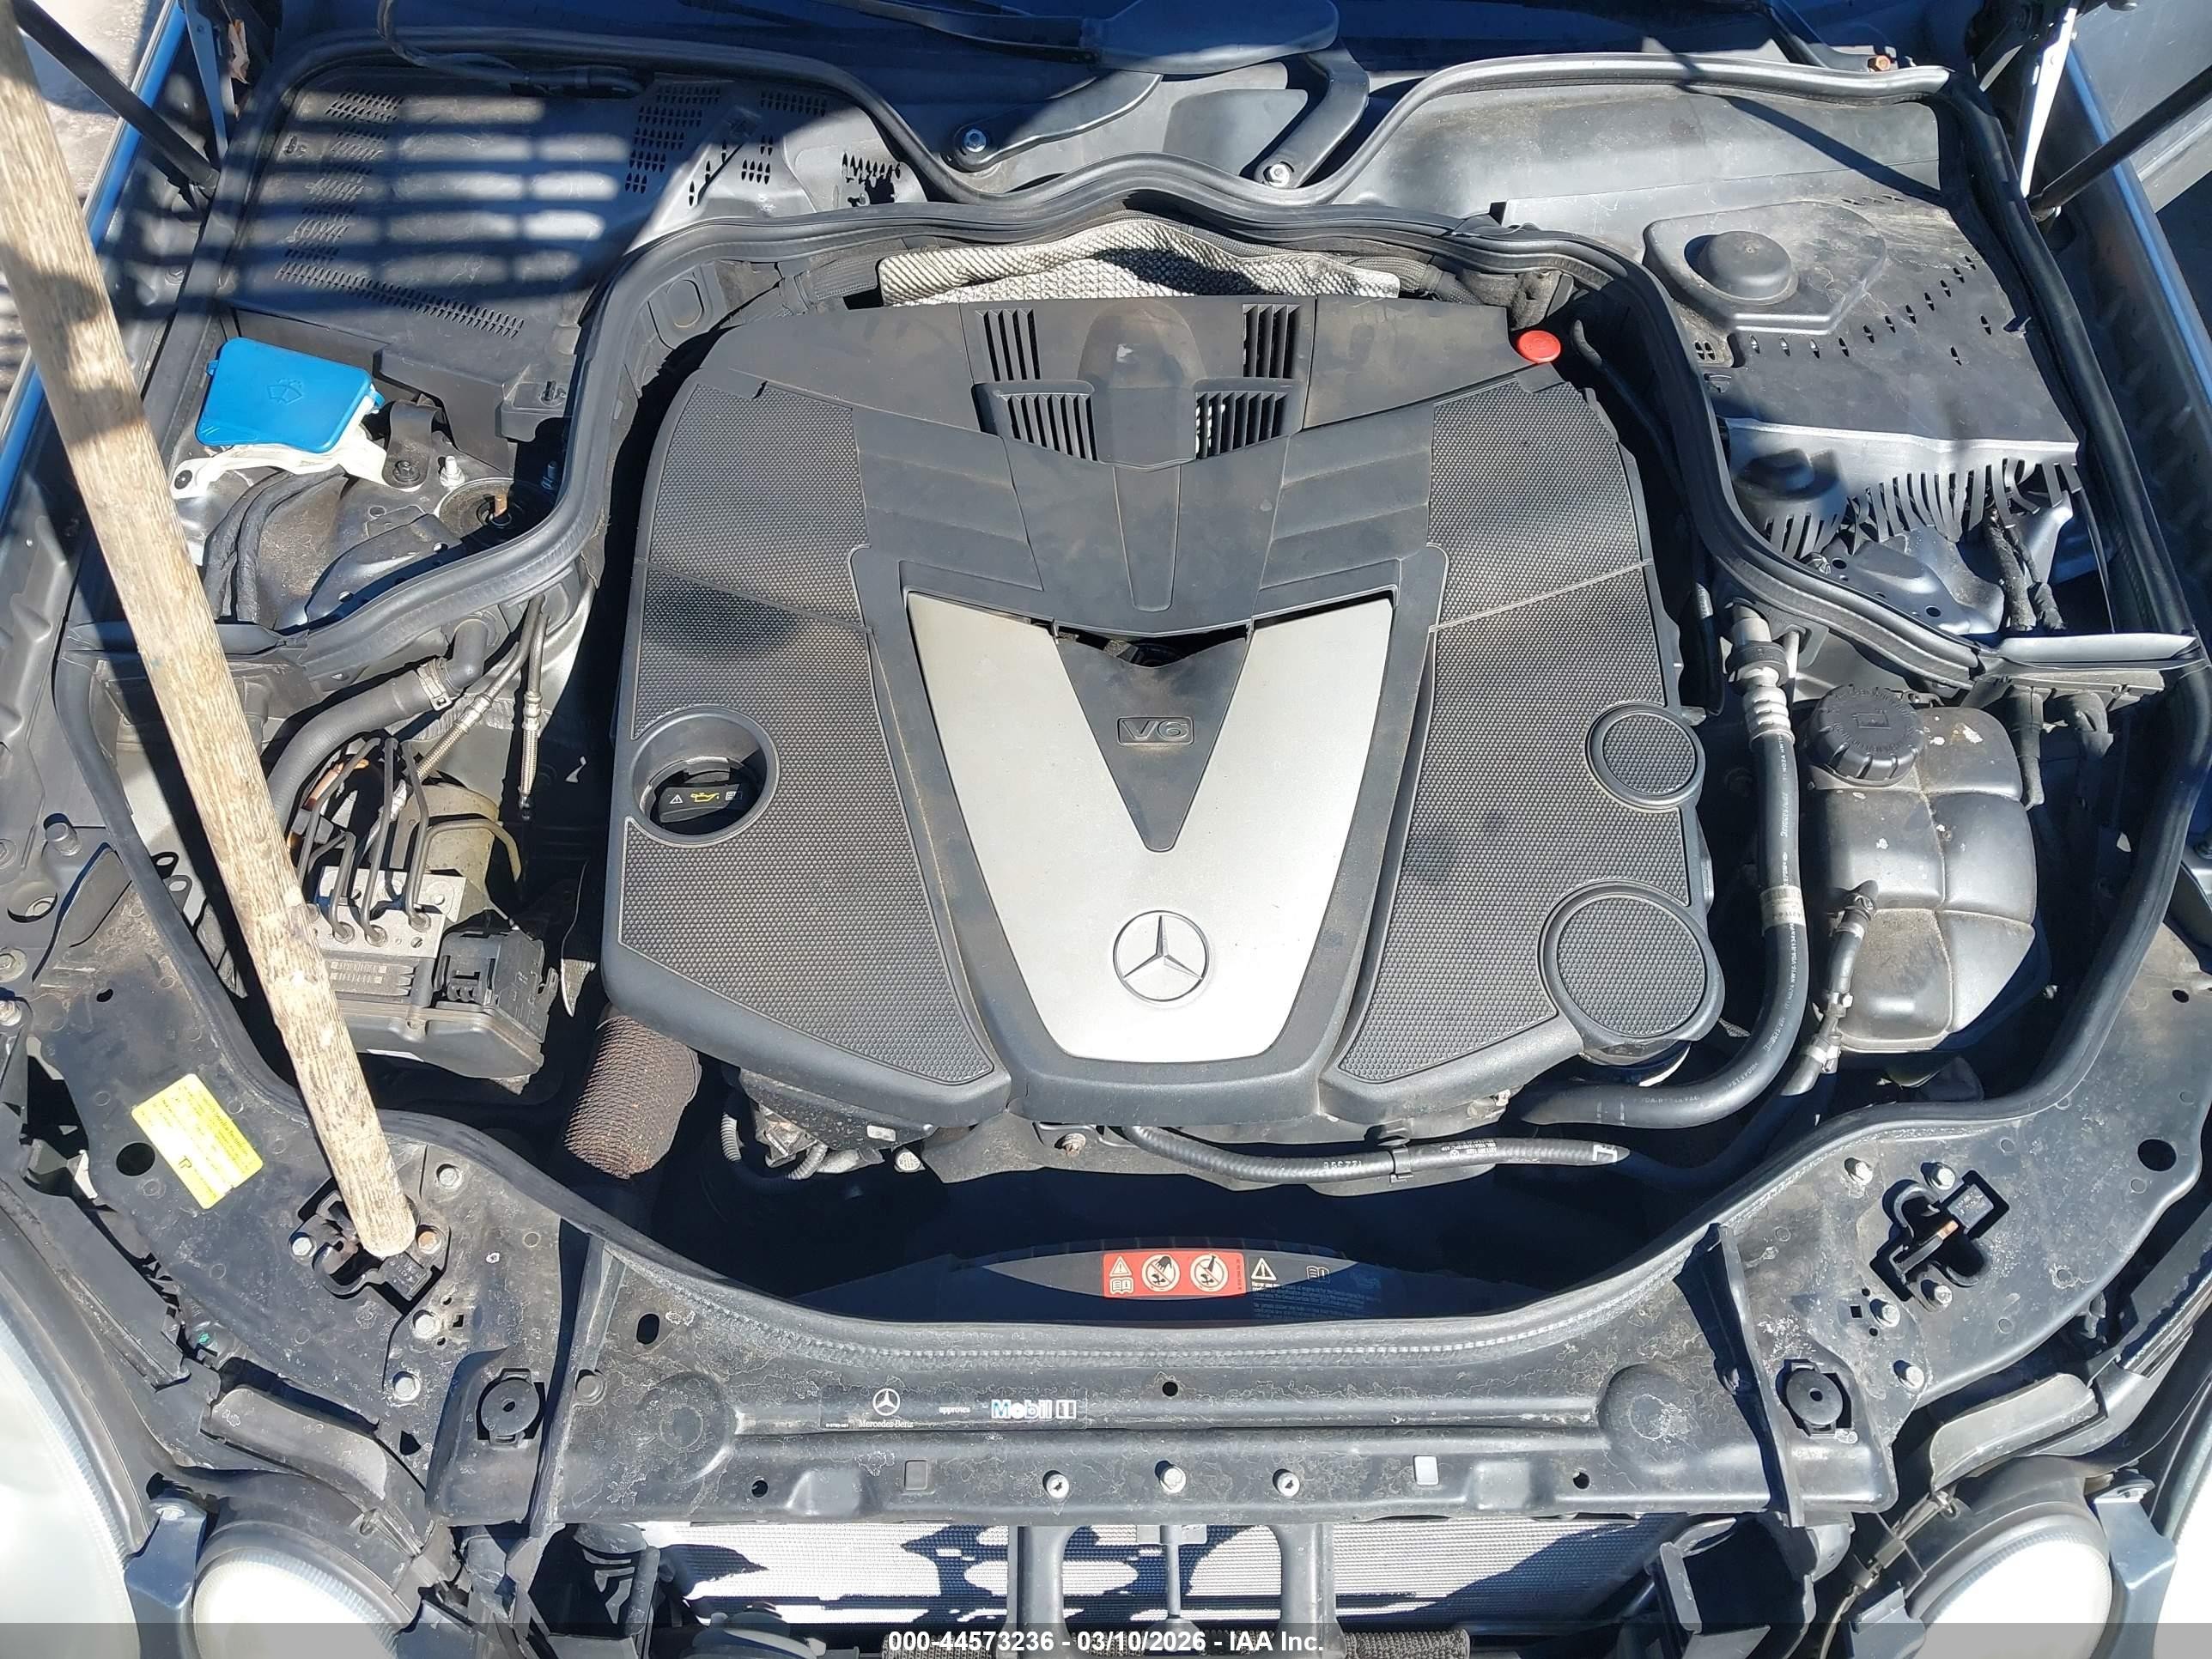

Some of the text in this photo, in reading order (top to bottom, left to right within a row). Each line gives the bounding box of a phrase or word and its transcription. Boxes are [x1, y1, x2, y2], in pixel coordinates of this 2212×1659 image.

[1121, 720, 1189, 740] V6
[939, 1406, 970, 1414] approves
[991, 1399, 1077, 1419] Mobil 1
[859, 1419, 914, 1429] Mercedes-Benz
